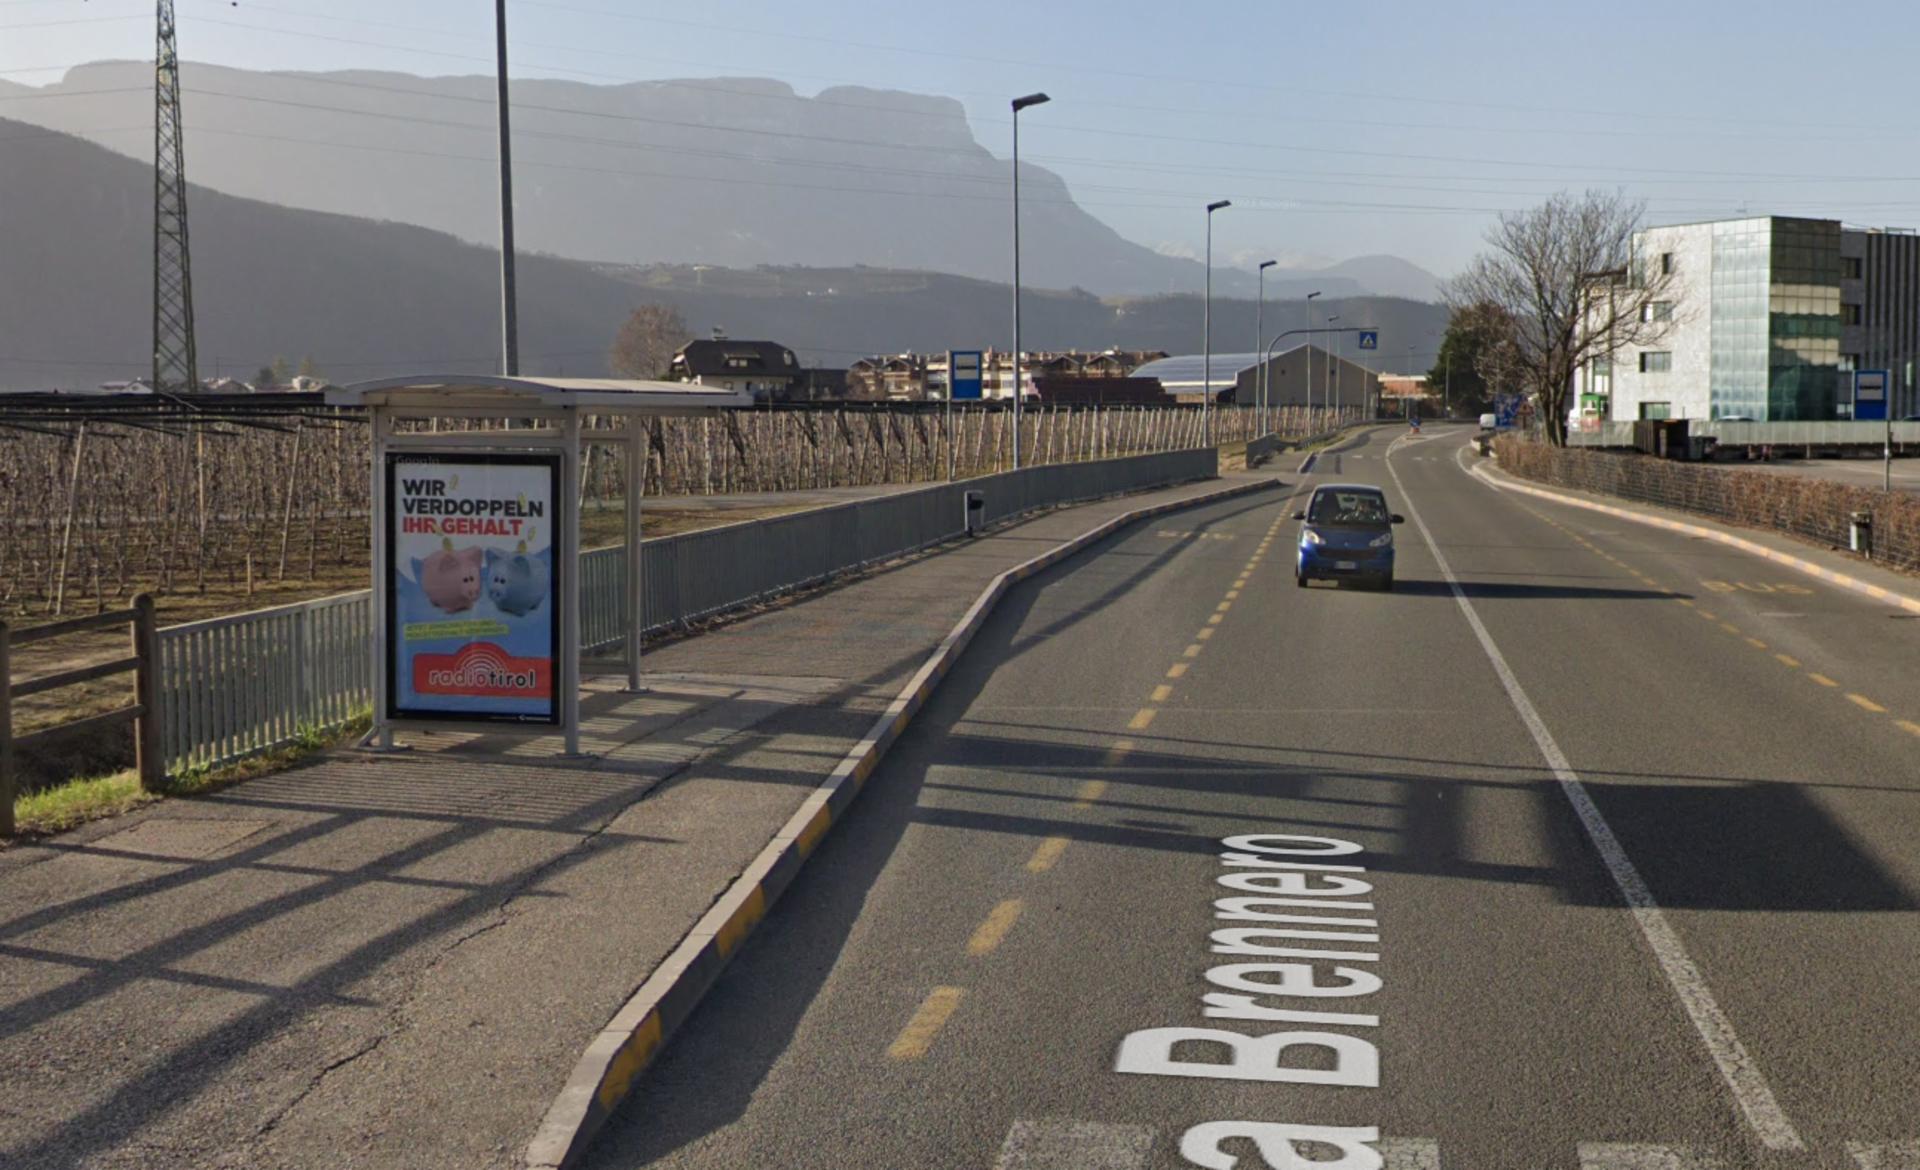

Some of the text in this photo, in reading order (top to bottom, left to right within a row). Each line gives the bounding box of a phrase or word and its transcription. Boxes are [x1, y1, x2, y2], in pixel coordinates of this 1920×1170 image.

[402, 478, 446, 497] WIR
[402, 498, 544, 518] VERDOPPELN
[402, 516, 524, 536] IHR GEHALT
[428, 668, 537, 689] radiotirol
